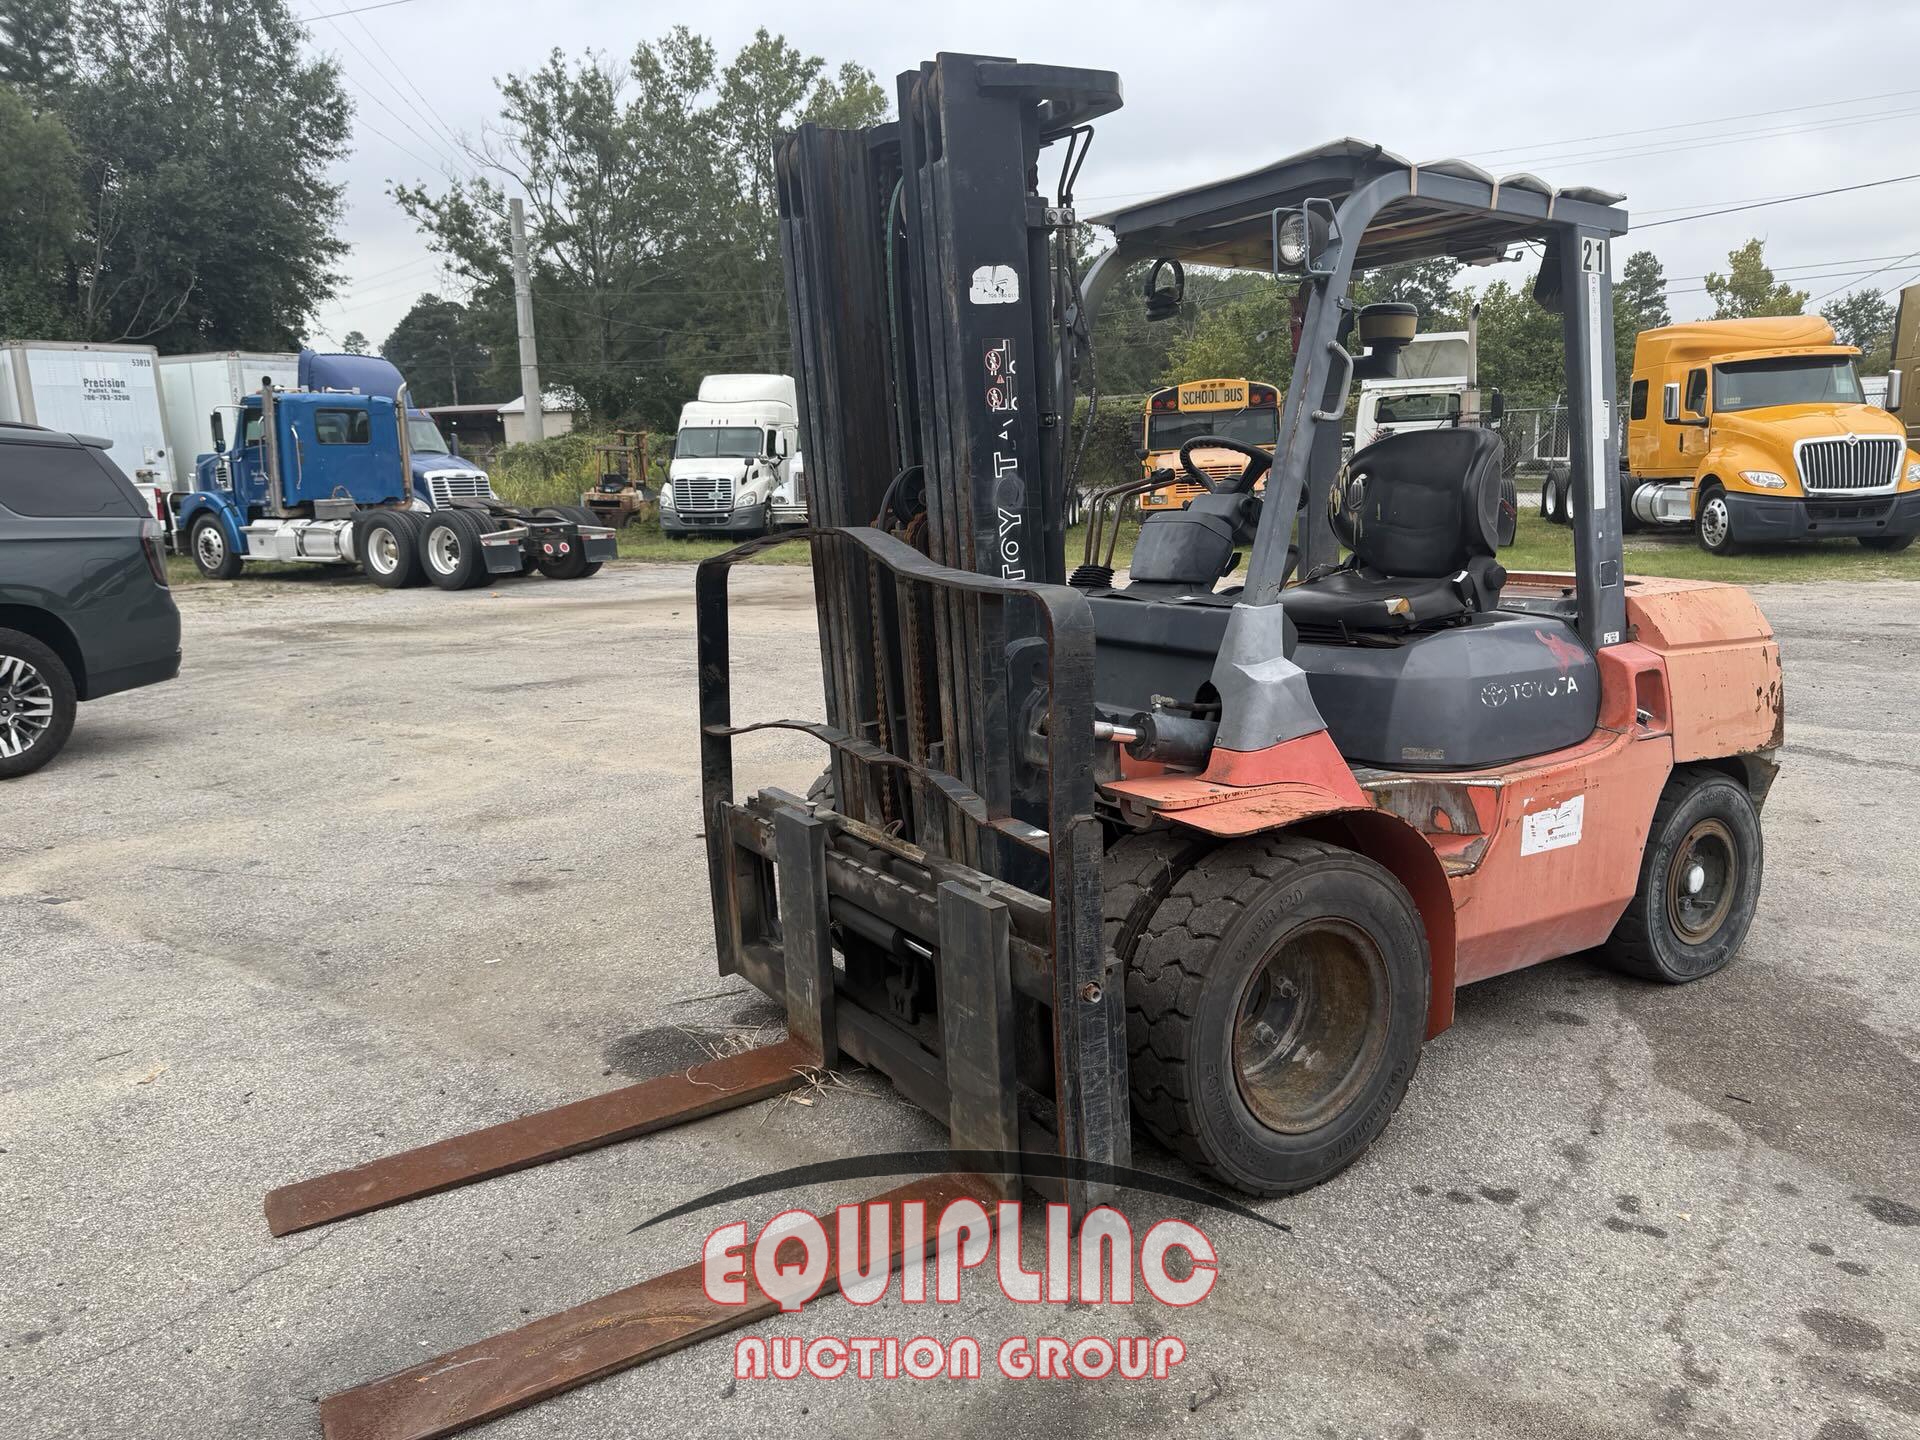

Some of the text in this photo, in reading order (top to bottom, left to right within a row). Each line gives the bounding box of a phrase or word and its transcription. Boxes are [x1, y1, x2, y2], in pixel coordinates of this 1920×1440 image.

[1583, 240, 1603, 272] 21
[83, 378, 126, 388] Precision
[1182, 388, 1243, 405] SCHOOL BUS
